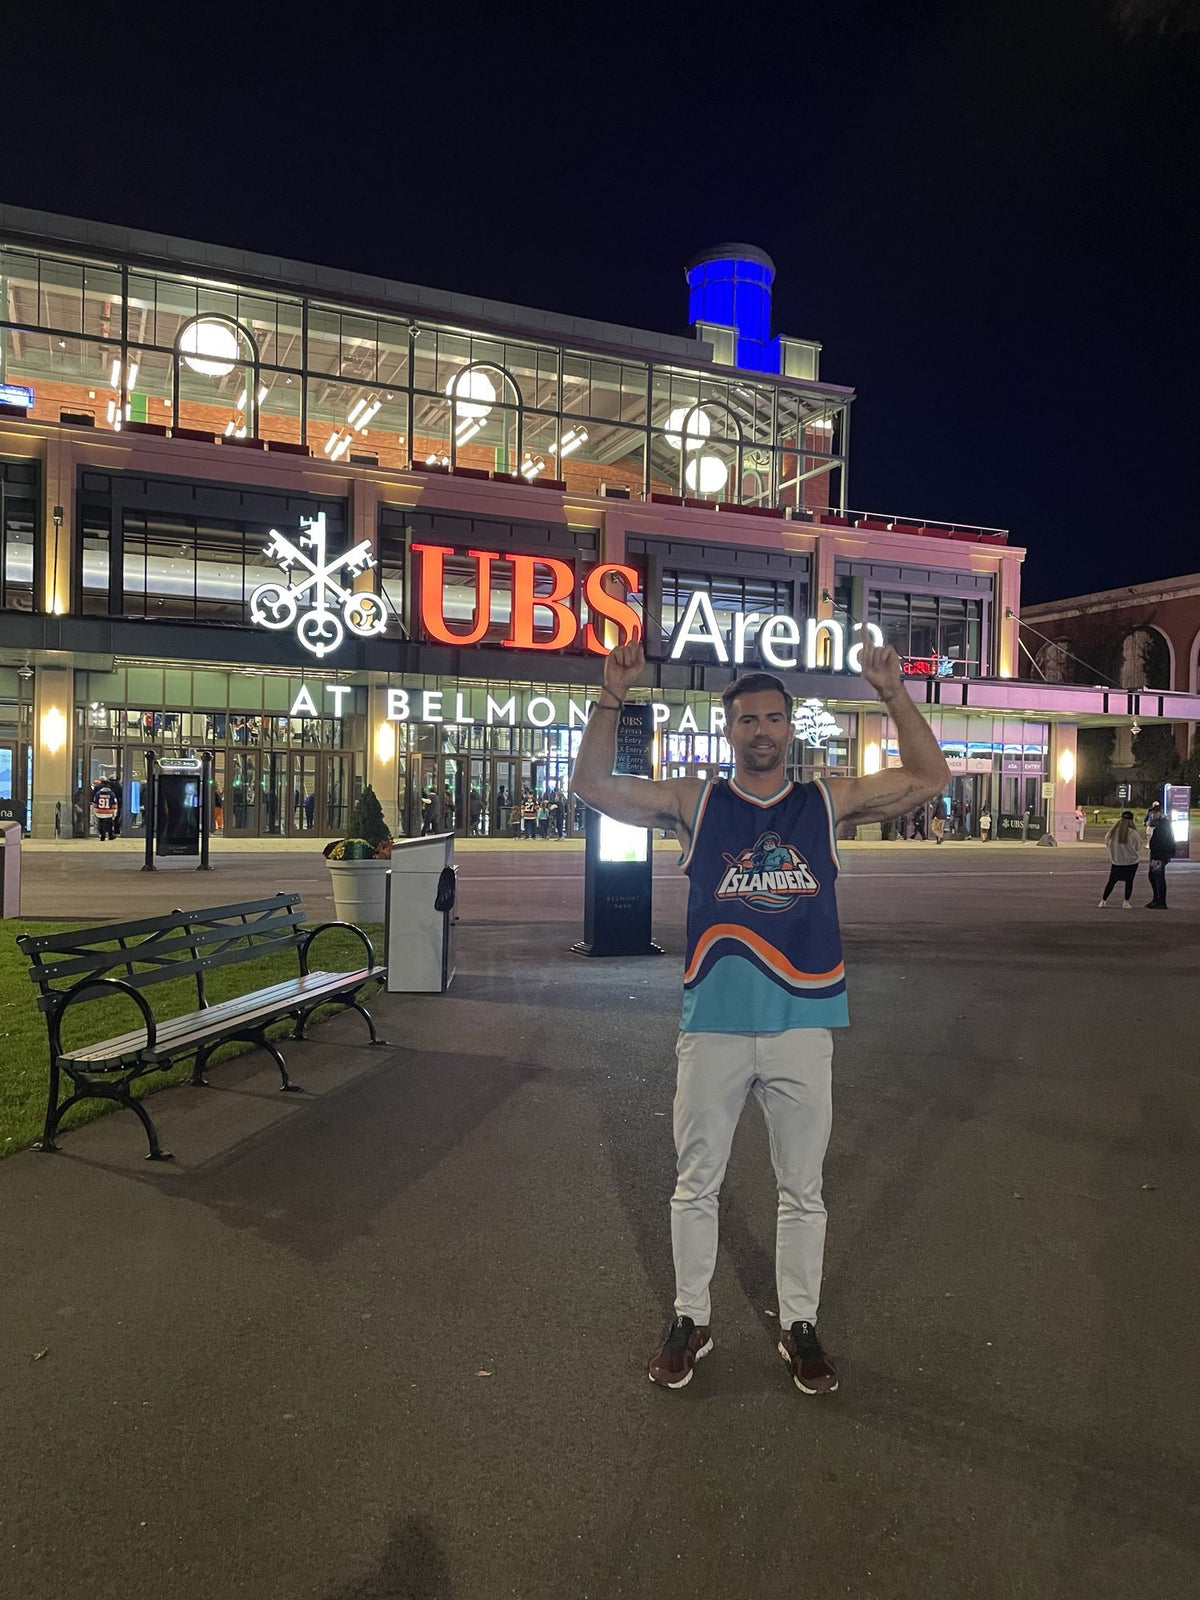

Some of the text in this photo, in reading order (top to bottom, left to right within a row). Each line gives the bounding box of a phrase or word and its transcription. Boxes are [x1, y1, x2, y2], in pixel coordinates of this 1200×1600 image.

[411, 543, 884, 673] UBS Arena
[290, 684, 728, 734] AT BELMON PAR
[624, 736, 641, 744] Entry
[625, 746, 643, 754] Entry
[626, 755, 644, 764] Entry
[98, 798, 110, 809] 91
[1010, 819, 1025, 829] UBS
[717, 863, 819, 896] ISLANDERS
